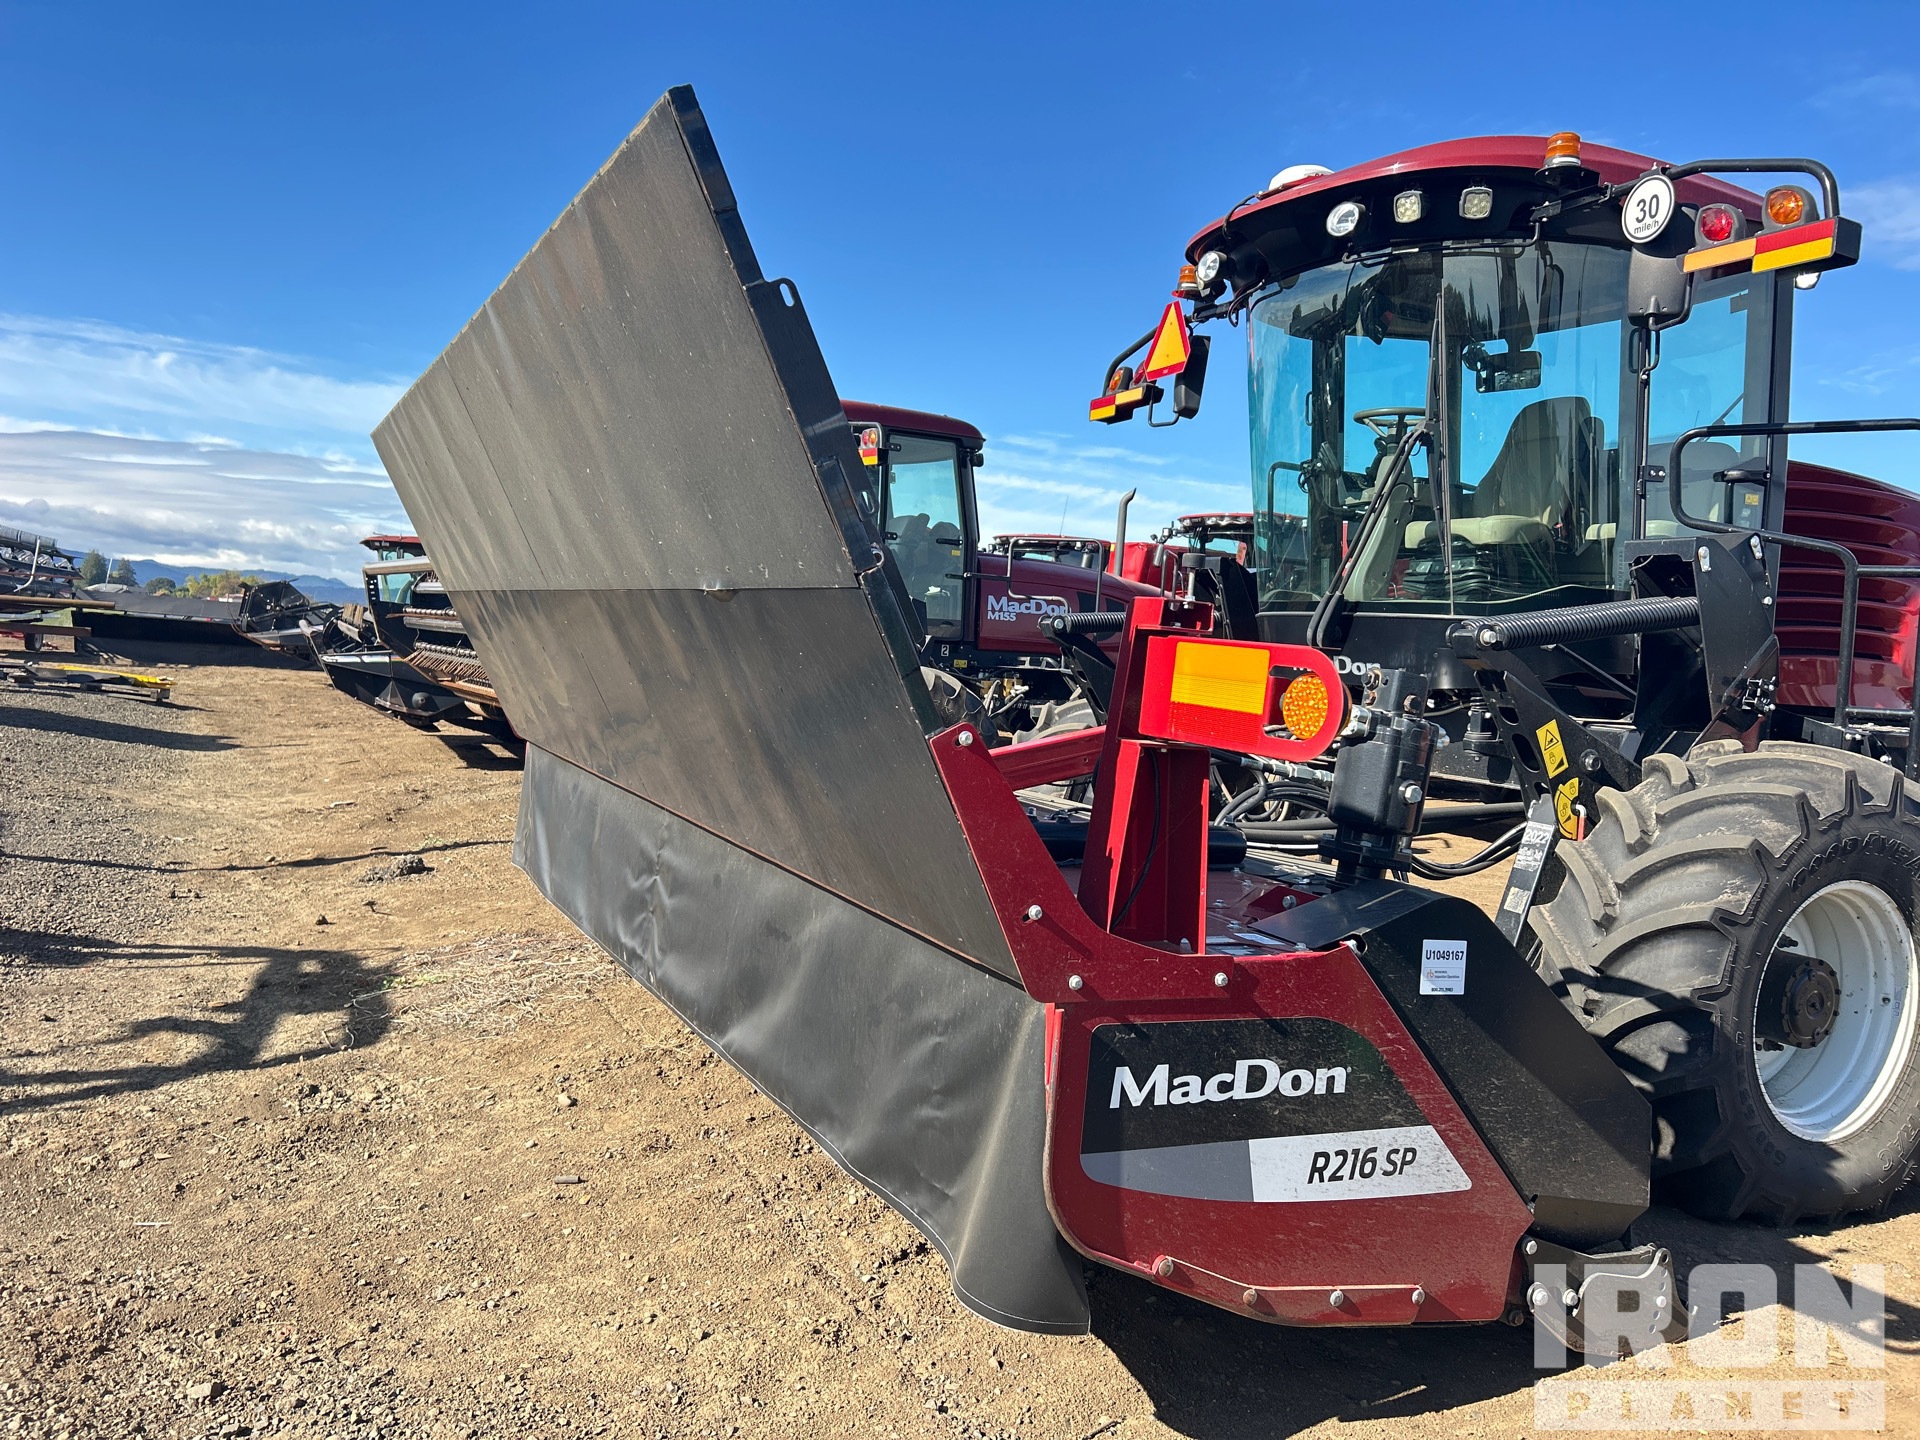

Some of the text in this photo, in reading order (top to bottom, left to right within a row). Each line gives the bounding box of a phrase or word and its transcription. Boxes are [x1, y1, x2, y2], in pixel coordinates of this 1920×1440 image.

[1635, 194, 1660, 223] 30
[1634, 219, 1660, 234] mile/h
[987, 611, 1017, 621] M155
[1525, 828, 1550, 844] 2022
[1425, 949, 1465, 961] U1049167
[1109, 1059, 1347, 1109] MacDon
[1307, 1146, 1417, 1184] R216 SP
